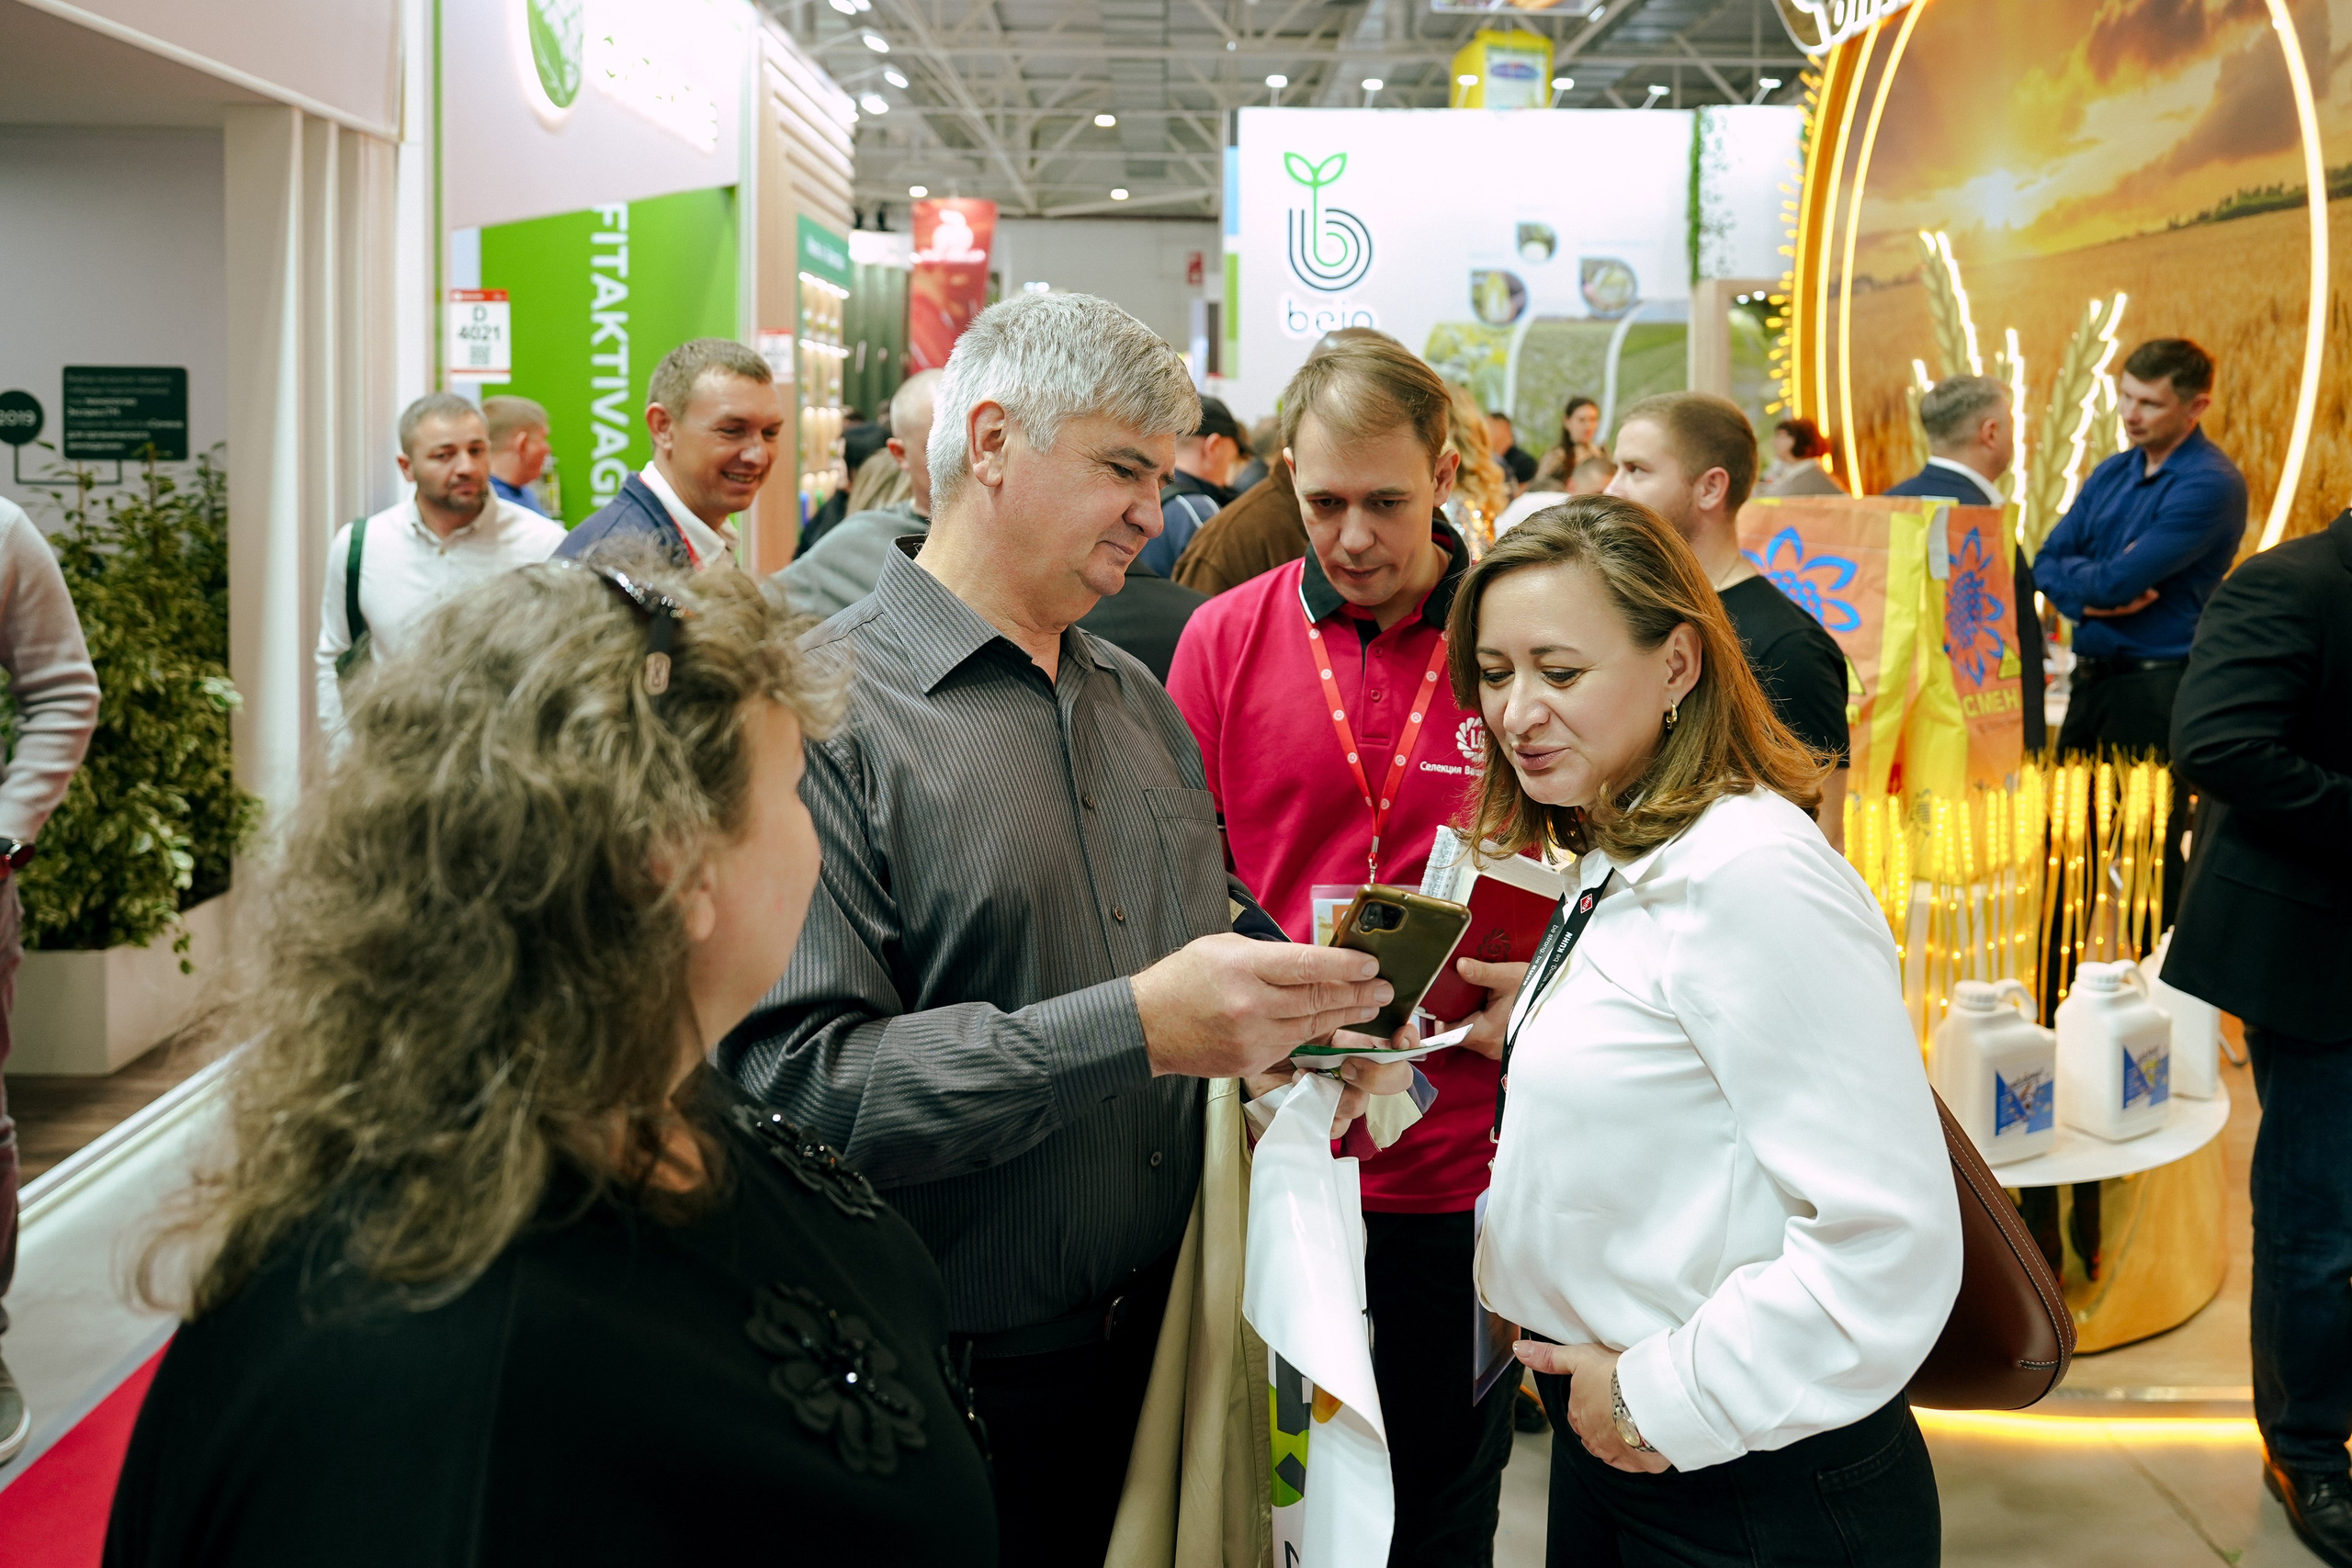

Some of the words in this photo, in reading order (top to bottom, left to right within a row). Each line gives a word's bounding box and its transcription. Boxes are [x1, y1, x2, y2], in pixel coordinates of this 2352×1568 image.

[471, 305, 489, 322] D
[458, 324, 502, 341] 4021
[1419, 761, 1463, 775] Селекция
[1464, 765, 1486, 777] Ваш
[1556, 931, 1574, 953] KUHN
